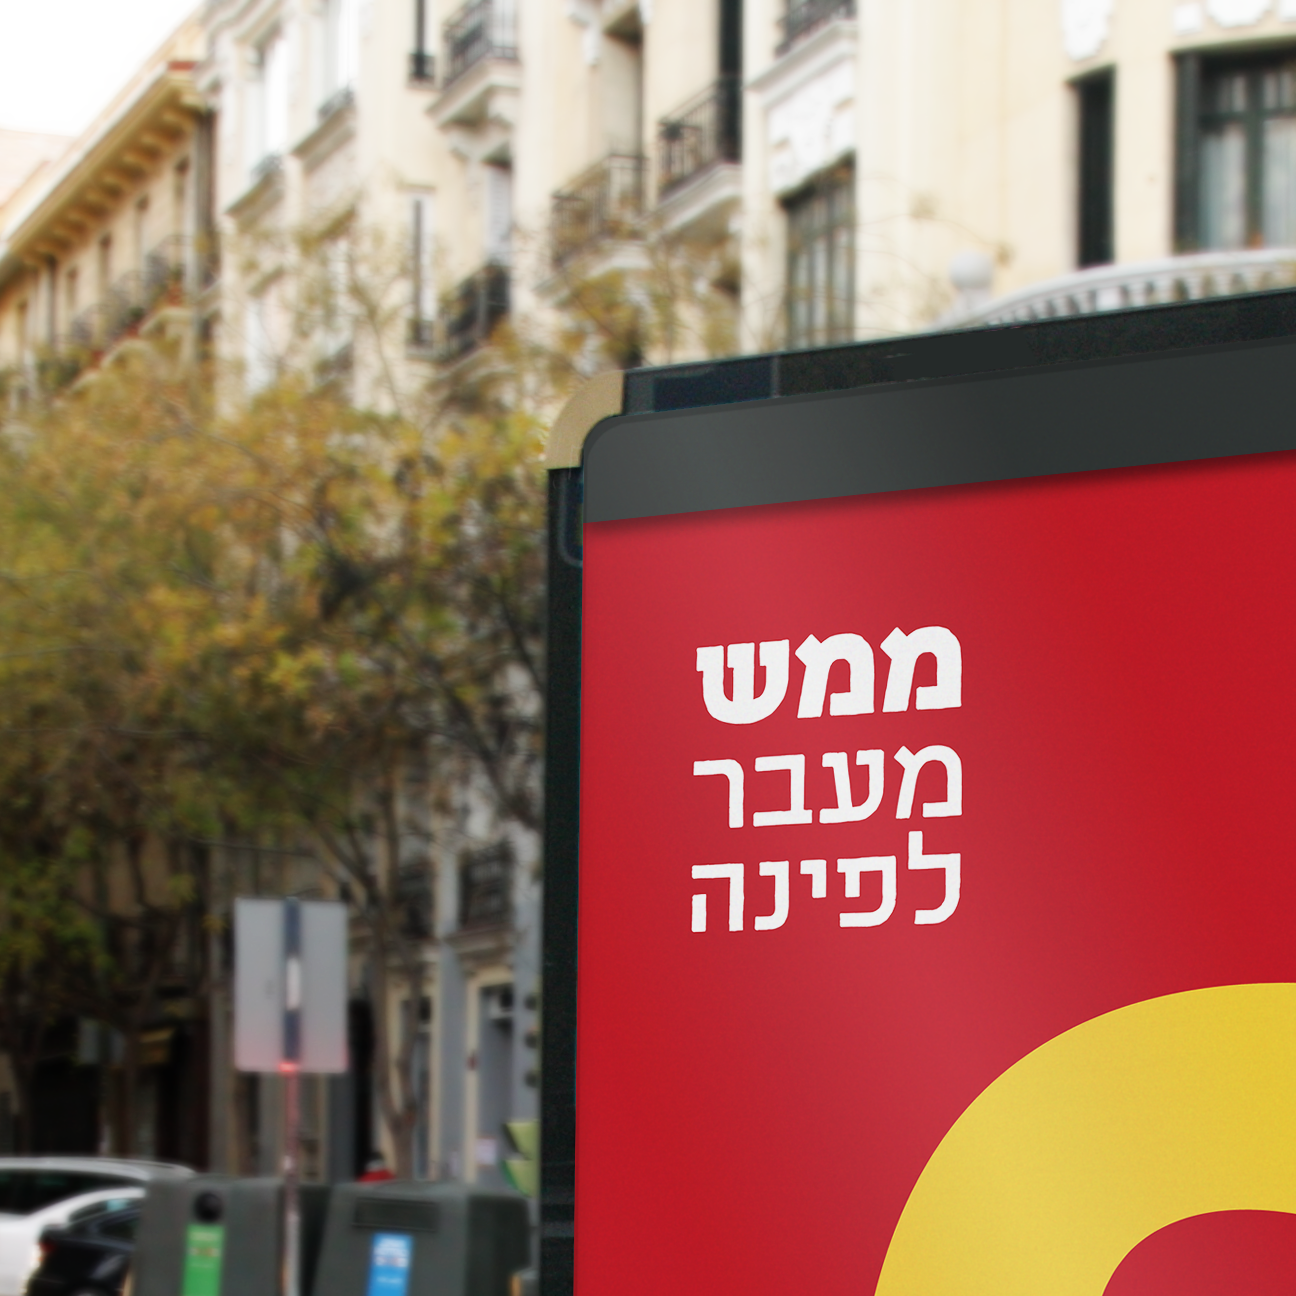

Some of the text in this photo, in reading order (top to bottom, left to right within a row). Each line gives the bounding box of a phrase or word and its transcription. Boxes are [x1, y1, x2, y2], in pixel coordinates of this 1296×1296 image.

[696, 625, 963, 725] ממש
[692, 744, 963, 829] מעבר
[691, 830, 962, 933] לפינה
